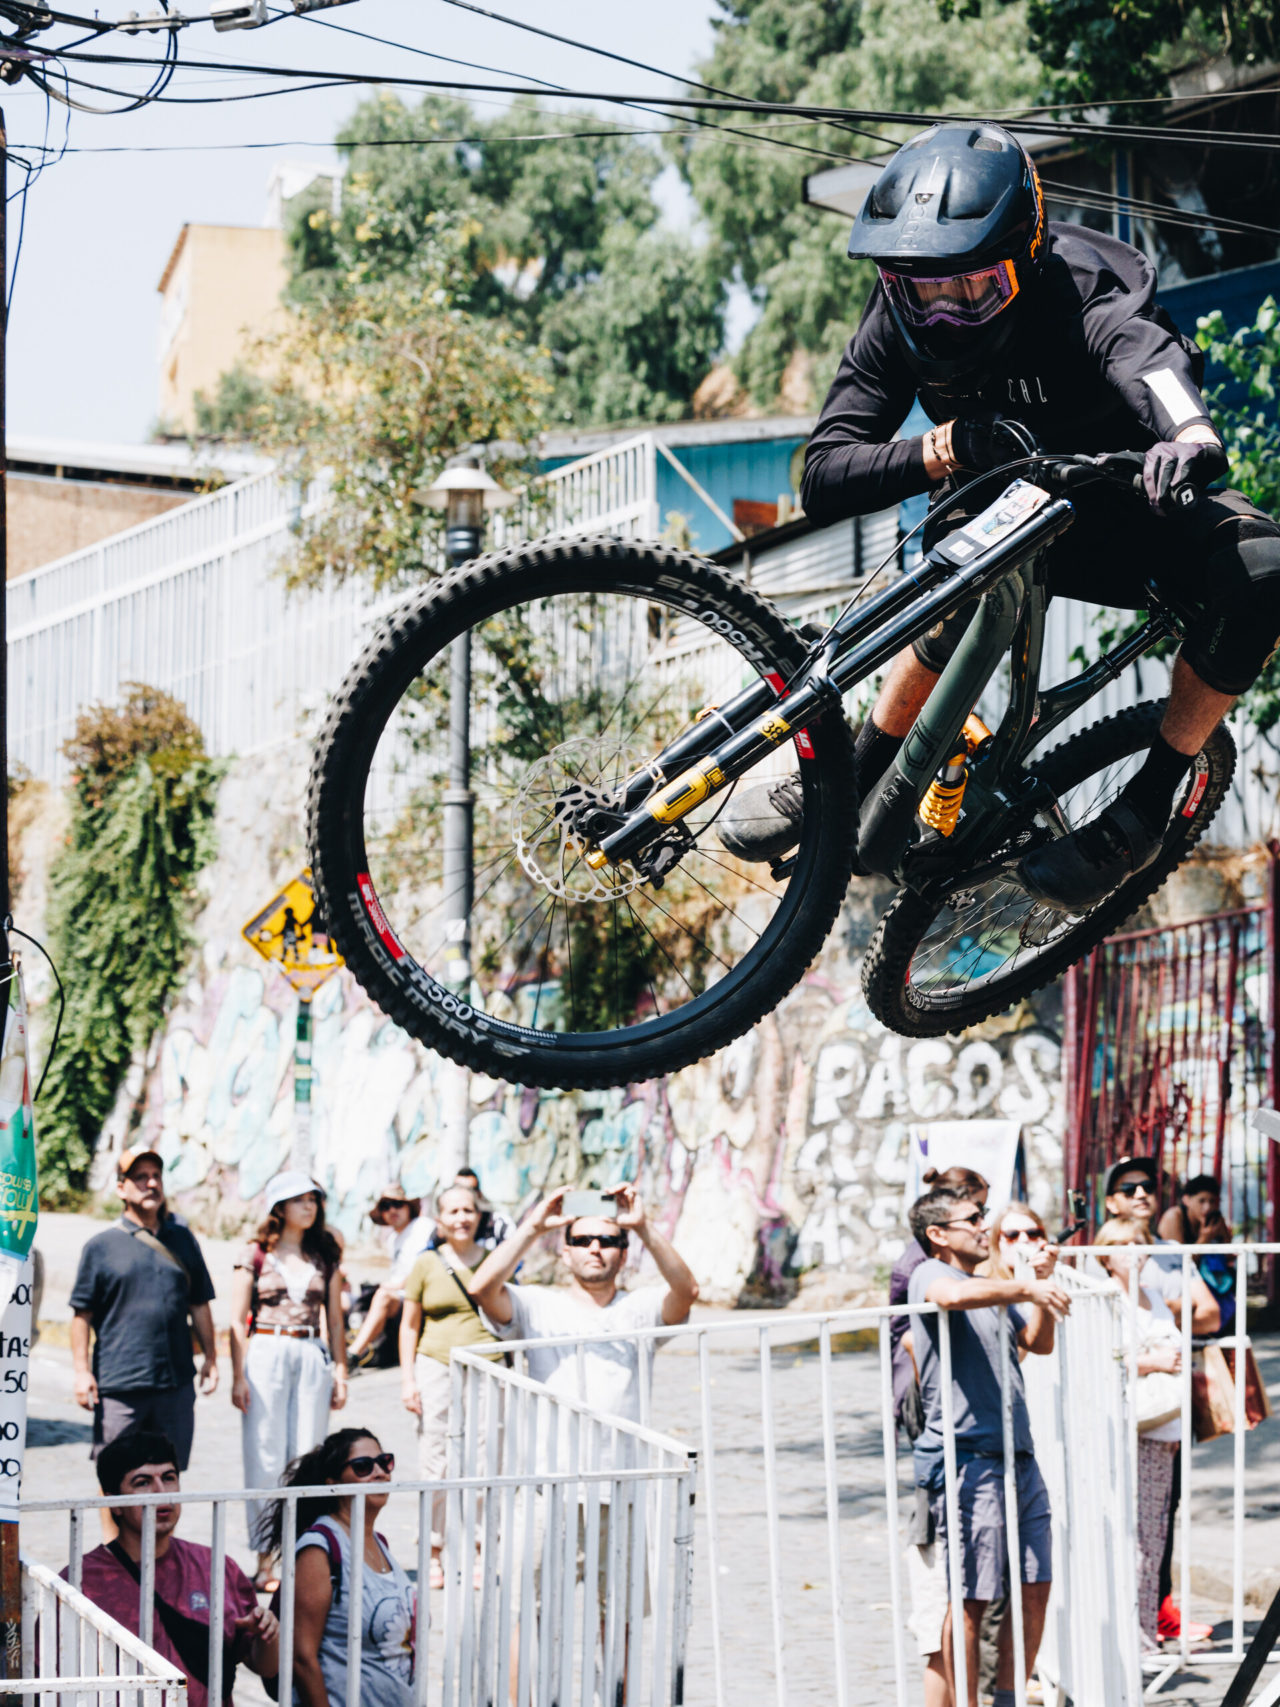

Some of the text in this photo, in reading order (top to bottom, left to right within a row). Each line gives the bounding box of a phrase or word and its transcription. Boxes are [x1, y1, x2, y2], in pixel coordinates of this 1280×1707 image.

[700, 610, 776, 676] FR560
[347, 891, 489, 1046] MAGIC MARY
[397, 953, 474, 1021] FR560
